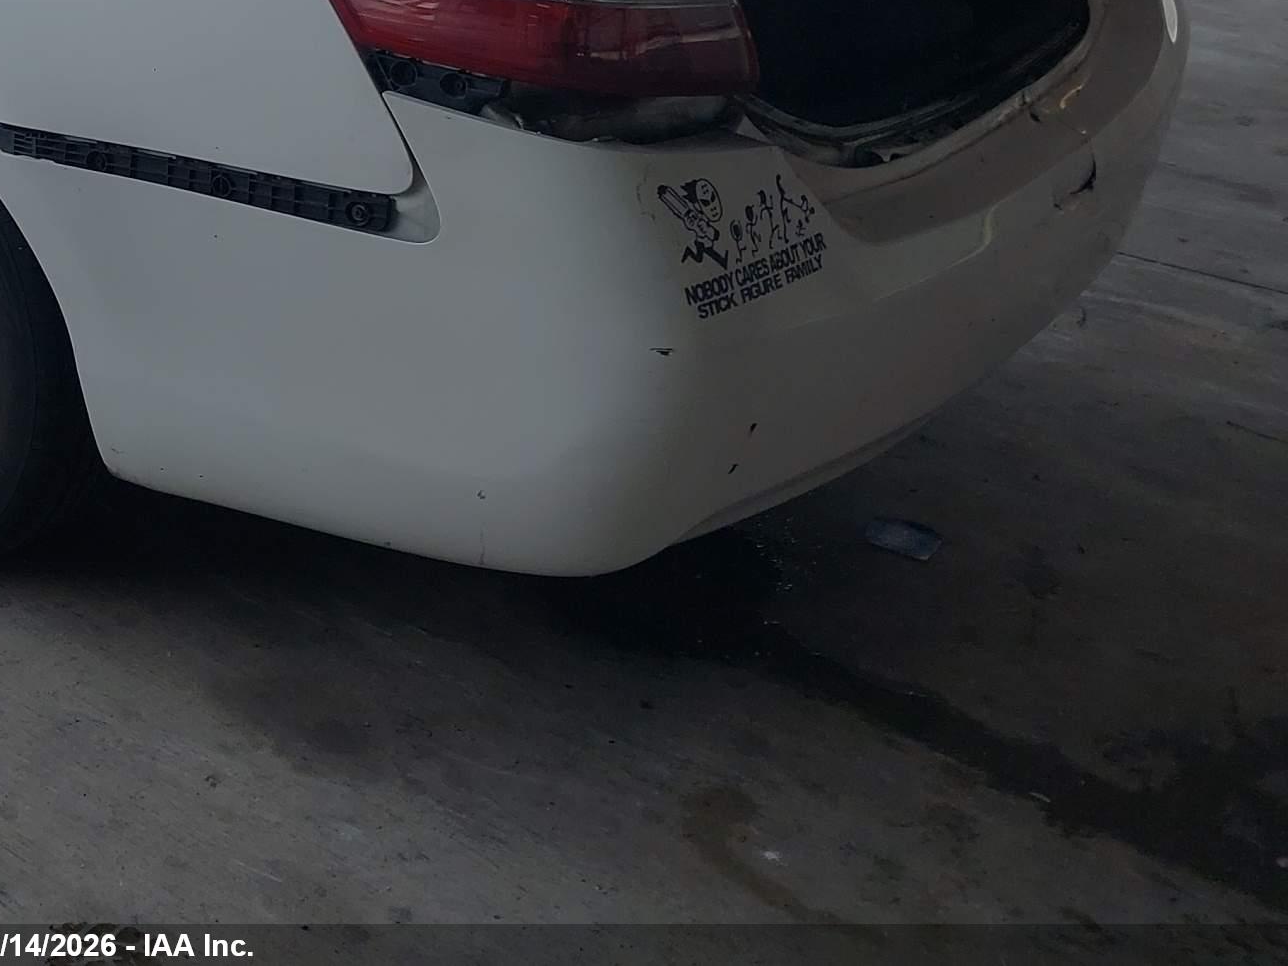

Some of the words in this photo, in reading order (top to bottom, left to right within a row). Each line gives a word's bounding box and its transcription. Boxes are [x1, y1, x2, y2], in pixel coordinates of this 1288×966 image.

[685, 271, 735, 305] NOBODY
[735, 258, 770, 285] CARES
[769, 243, 802, 273] ABOUT
[800, 232, 827, 257] YOUR
[697, 292, 738, 319] STICK
[740, 273, 783, 303] FIGURE
[784, 254, 824, 283] FAMILY
